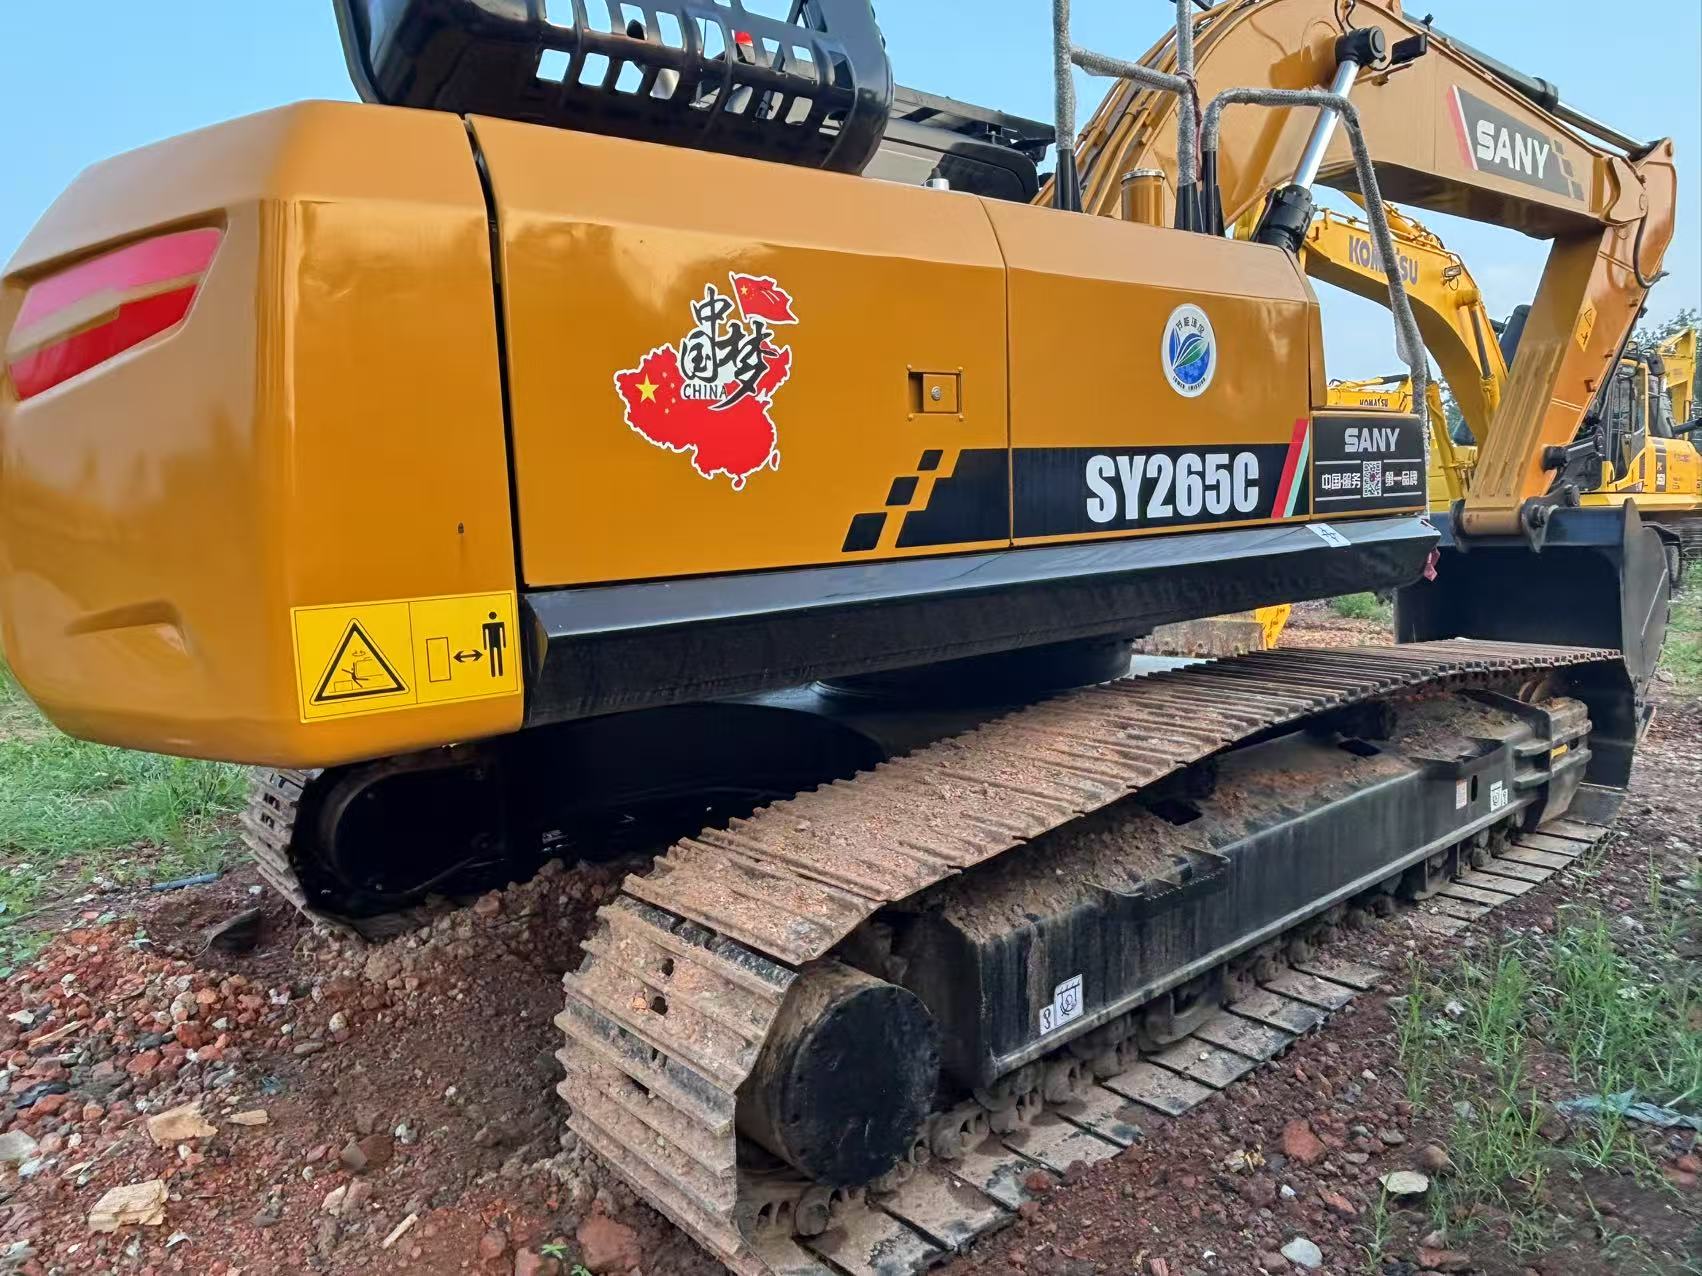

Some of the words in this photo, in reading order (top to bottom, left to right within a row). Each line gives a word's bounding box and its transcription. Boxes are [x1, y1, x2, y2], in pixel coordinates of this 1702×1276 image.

[1476, 119, 1550, 180] SANY
[1348, 234, 1419, 286] KOMSU
[683, 382, 728, 400] CHINA
[1344, 427, 1400, 453] SANY
[1085, 451, 1260, 523] SY265C
